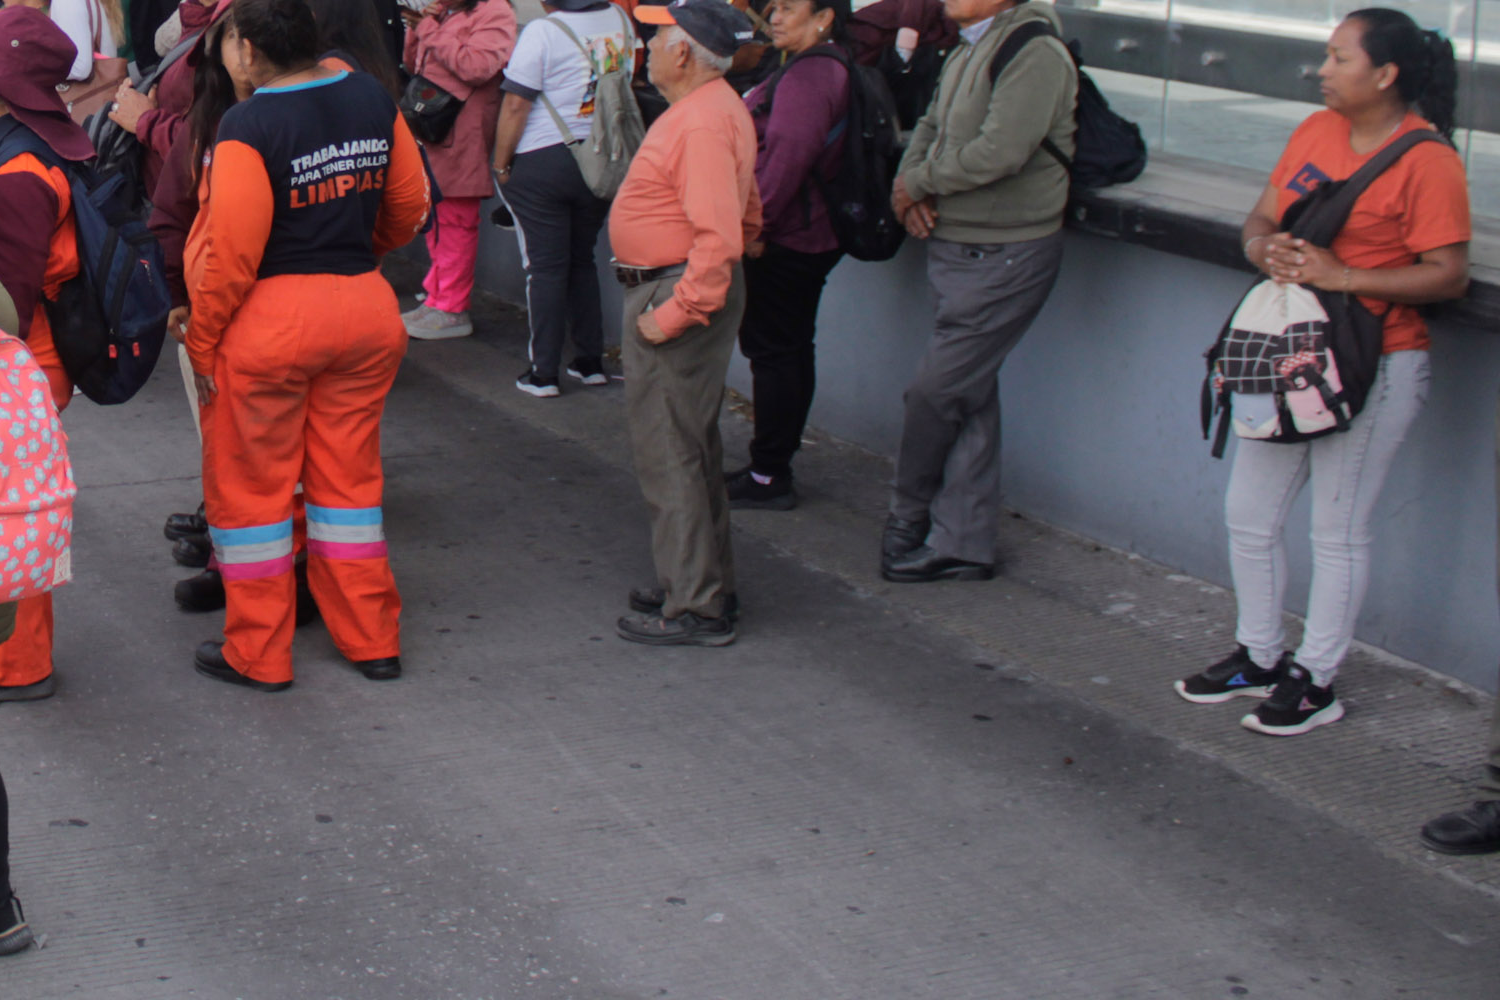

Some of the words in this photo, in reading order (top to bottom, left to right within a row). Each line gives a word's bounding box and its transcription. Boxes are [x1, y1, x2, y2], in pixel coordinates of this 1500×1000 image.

[291, 139, 389, 173] TRABAJANDO
[291, 169, 321, 186] PARA
[322, 159, 355, 176] TENER
[356, 154, 387, 168] CALLES
[290, 168, 384, 208] LIMPIAS
